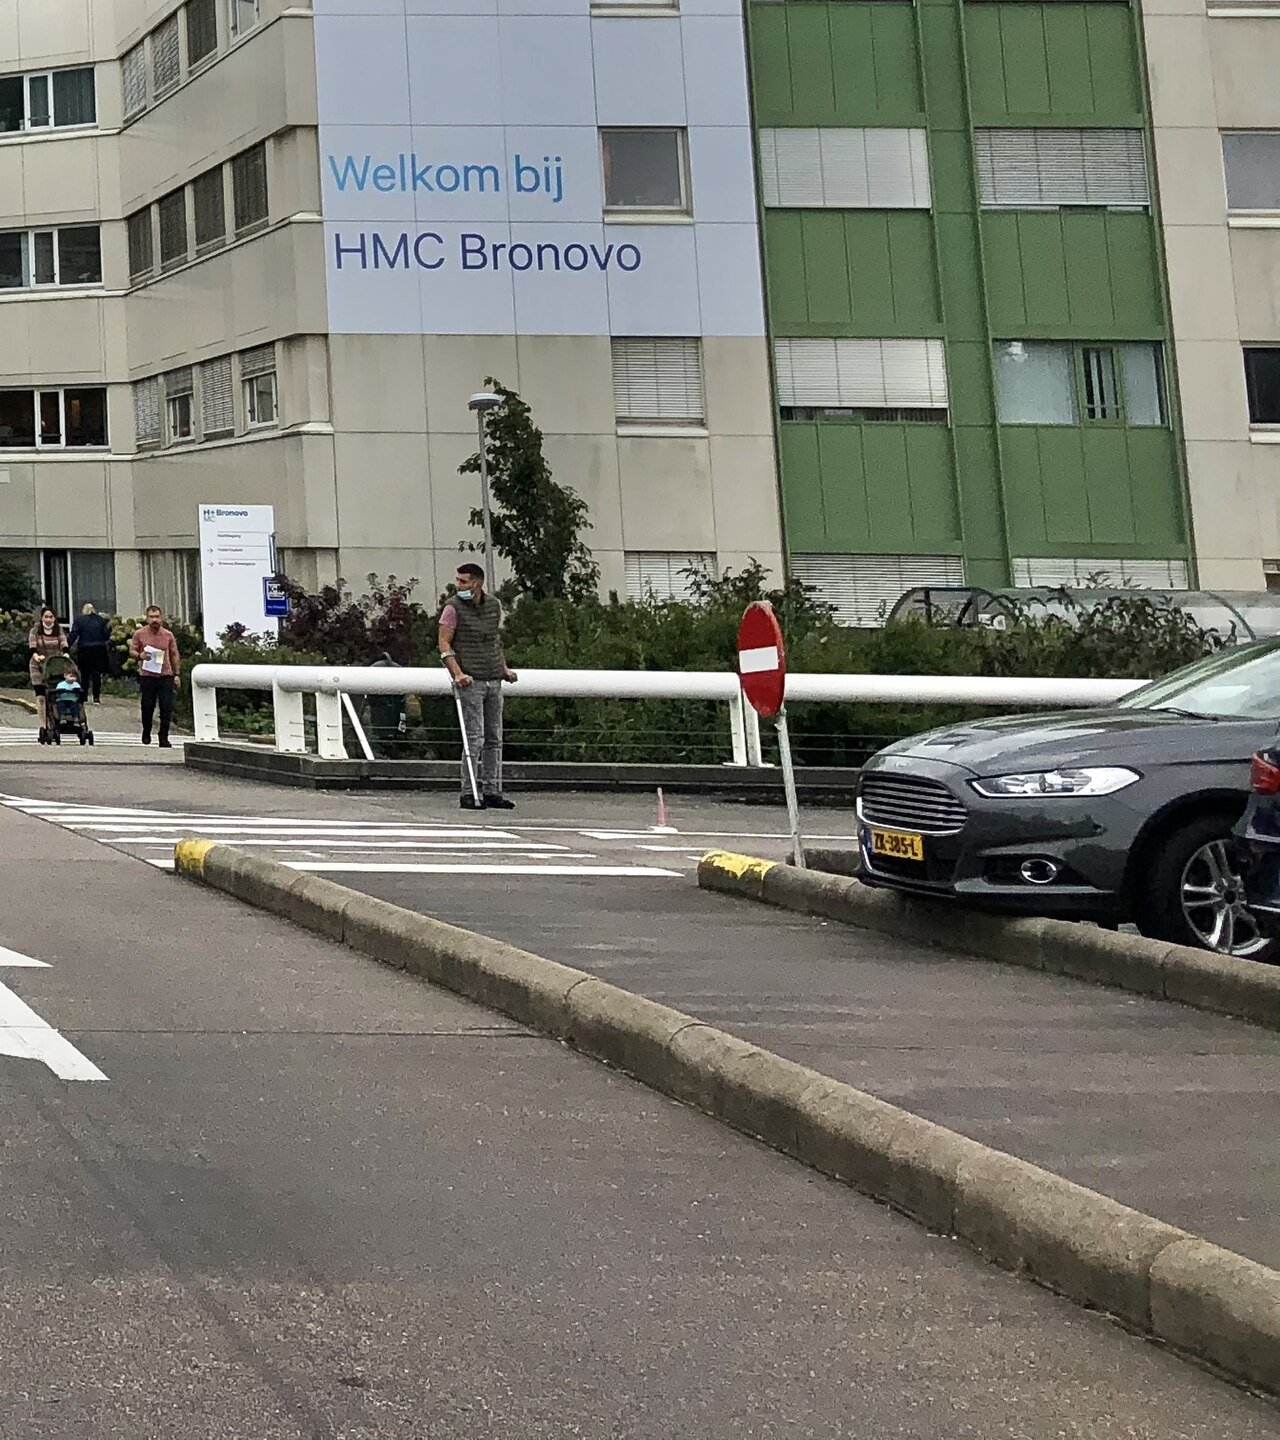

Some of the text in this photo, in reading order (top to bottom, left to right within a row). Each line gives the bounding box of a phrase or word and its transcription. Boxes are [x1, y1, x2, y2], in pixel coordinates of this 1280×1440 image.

[328, 153, 565, 204] Welkom bij
[335, 232, 643, 272] HMC Bronovo
[216, 509, 249, 517] Bronovo
